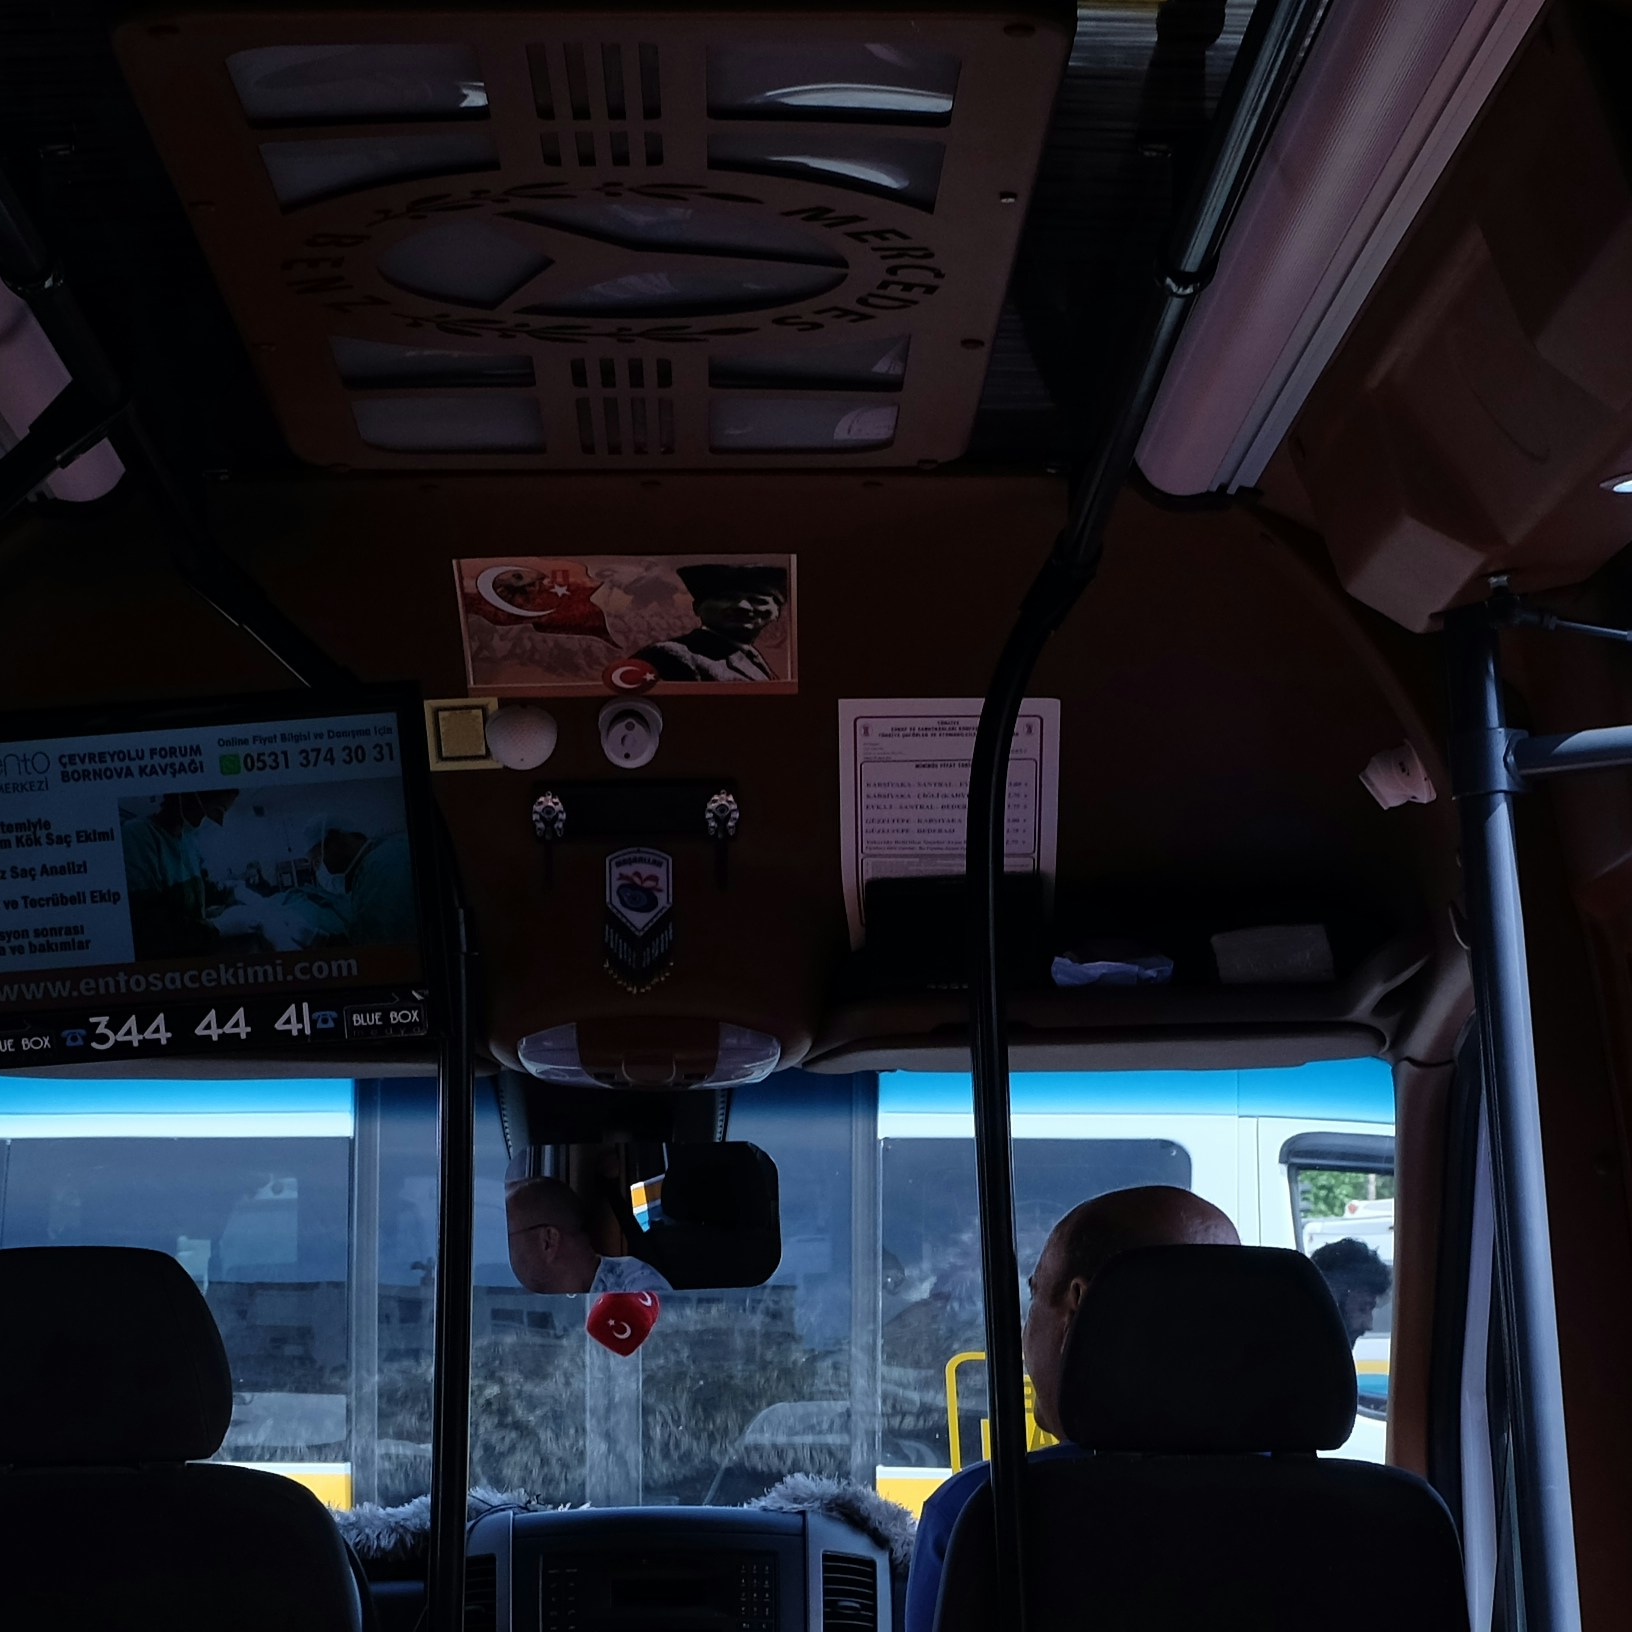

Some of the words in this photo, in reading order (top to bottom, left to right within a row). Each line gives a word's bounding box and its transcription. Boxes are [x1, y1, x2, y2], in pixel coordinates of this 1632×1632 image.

[279, 231, 392, 315] BENZ
[771, 204, 947, 334] MERCEDES
[217, 737, 249, 748] Online
[252, 734, 277, 747] Fiyat
[280, 732, 310, 744] Bilgisi
[313, 732, 324, 740] ve
[327, 729, 371, 740] Danışma
[58, 750, 145, 768] ÇEVREYOLU
[149, 744, 202, 760] FORUM
[243, 750, 290, 772] 0531
[299, 747, 336, 768] 374
[342, 745, 366, 765] 30
[372, 743, 394, 763] 31
[60, 764, 135, 783] BORNOVA
[141, 759, 204, 779] KAVŞAĞI
[15, 833, 42, 848] Kök
[46, 832, 72, 848] Saç
[76, 827, 116, 844] Ekimi
[10, 865, 36, 881] Saç
[40, 861, 88, 877] Analizi
[3, 898, 19, 910] ve
[21, 891, 87, 909] Tecrübeli
[90, 889, 121, 905] Ekip
[33, 925, 85, 938] sonrası
[9, 944, 25, 956] ve
[28, 938, 92, 955] bakımlar
[88, 1011, 172, 1051] 344
[193, 1006, 252, 1041] 44
[273, 1001, 311, 1037] 41
[352, 1012, 384, 1027] BLUE
[389, 1009, 420, 1025] BOX
[21, 1035, 52, 1051] BOX
